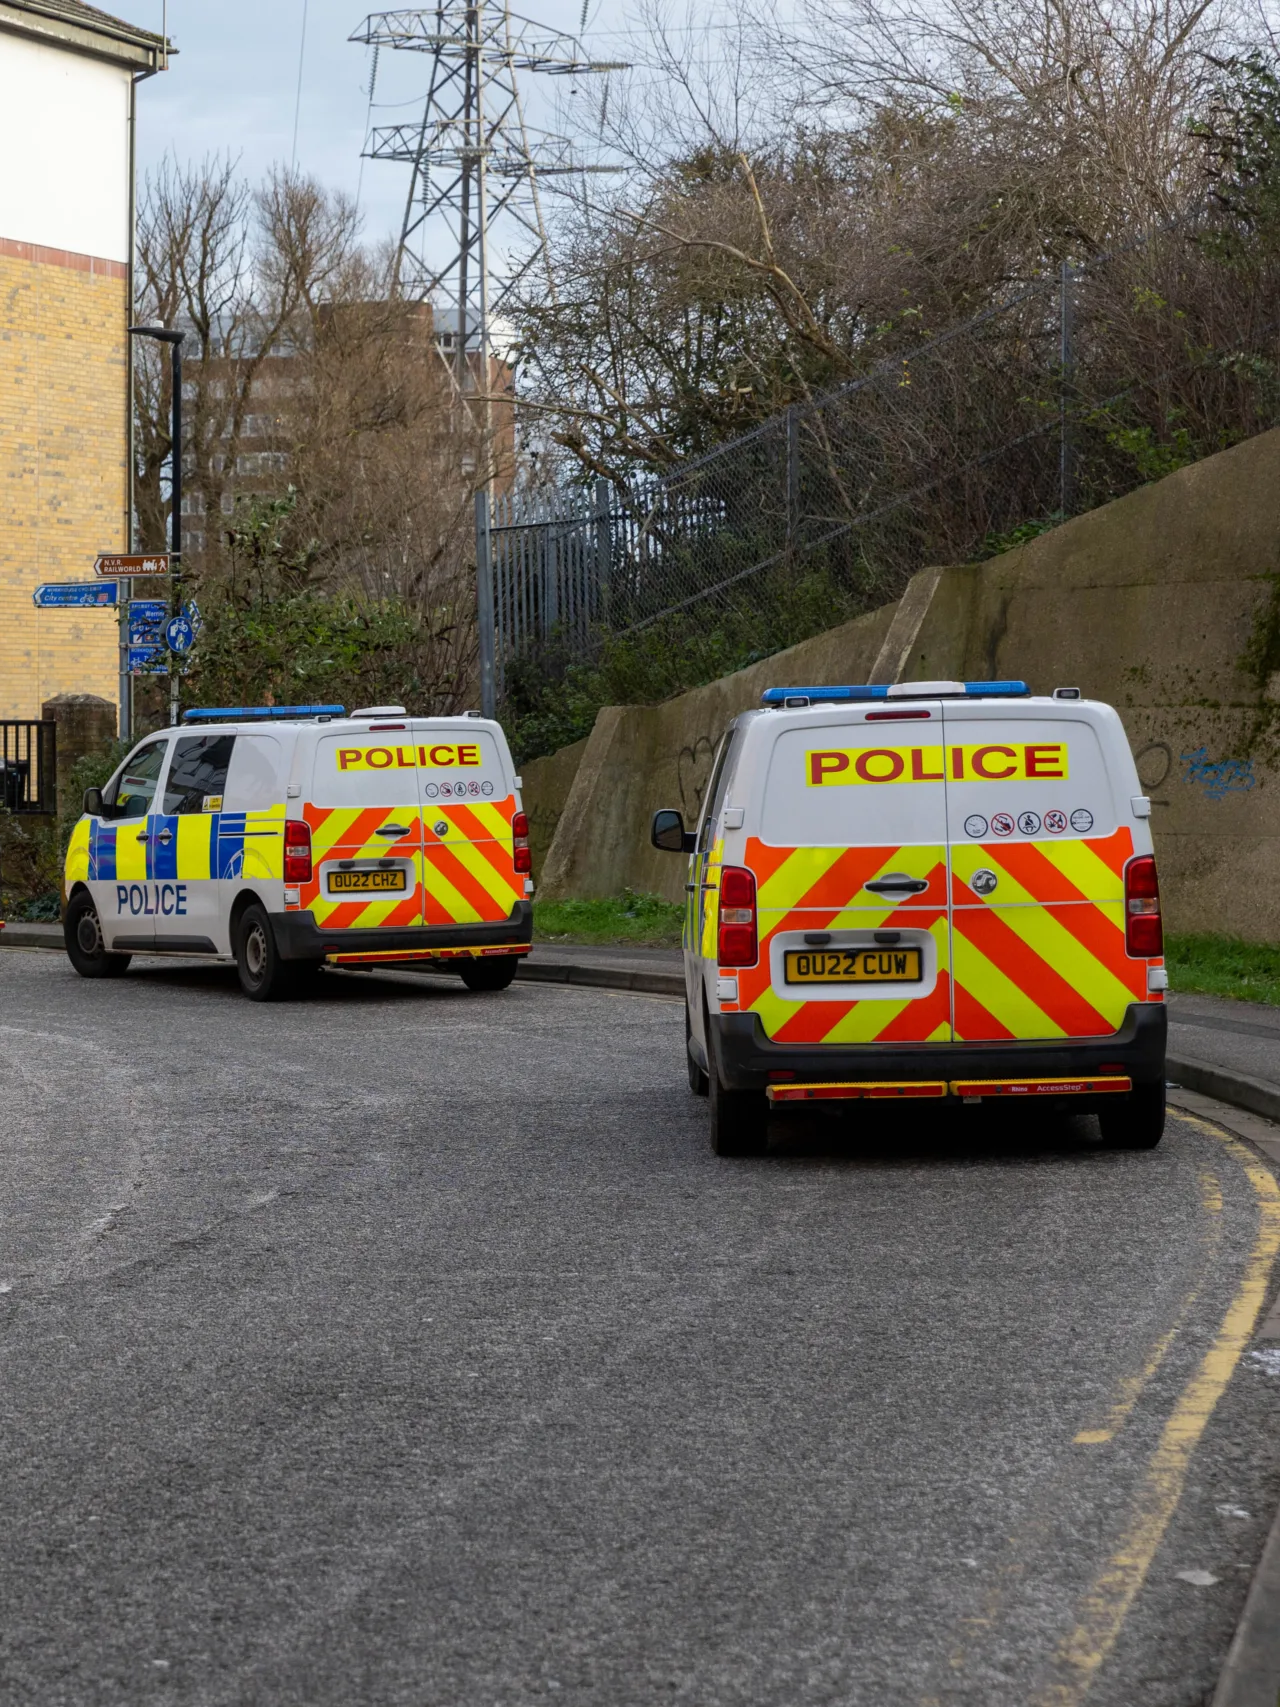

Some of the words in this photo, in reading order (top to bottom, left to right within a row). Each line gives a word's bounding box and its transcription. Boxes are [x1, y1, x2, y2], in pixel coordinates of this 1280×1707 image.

[339, 745, 479, 769] POLICE
[811, 746, 1063, 784] POLICE
[334, 874, 369, 887] OU22
[372, 873, 398, 886] CHZ
[116, 884, 187, 915] POLICE
[797, 955, 856, 976] OU22
[863, 954, 907, 975] CUW
